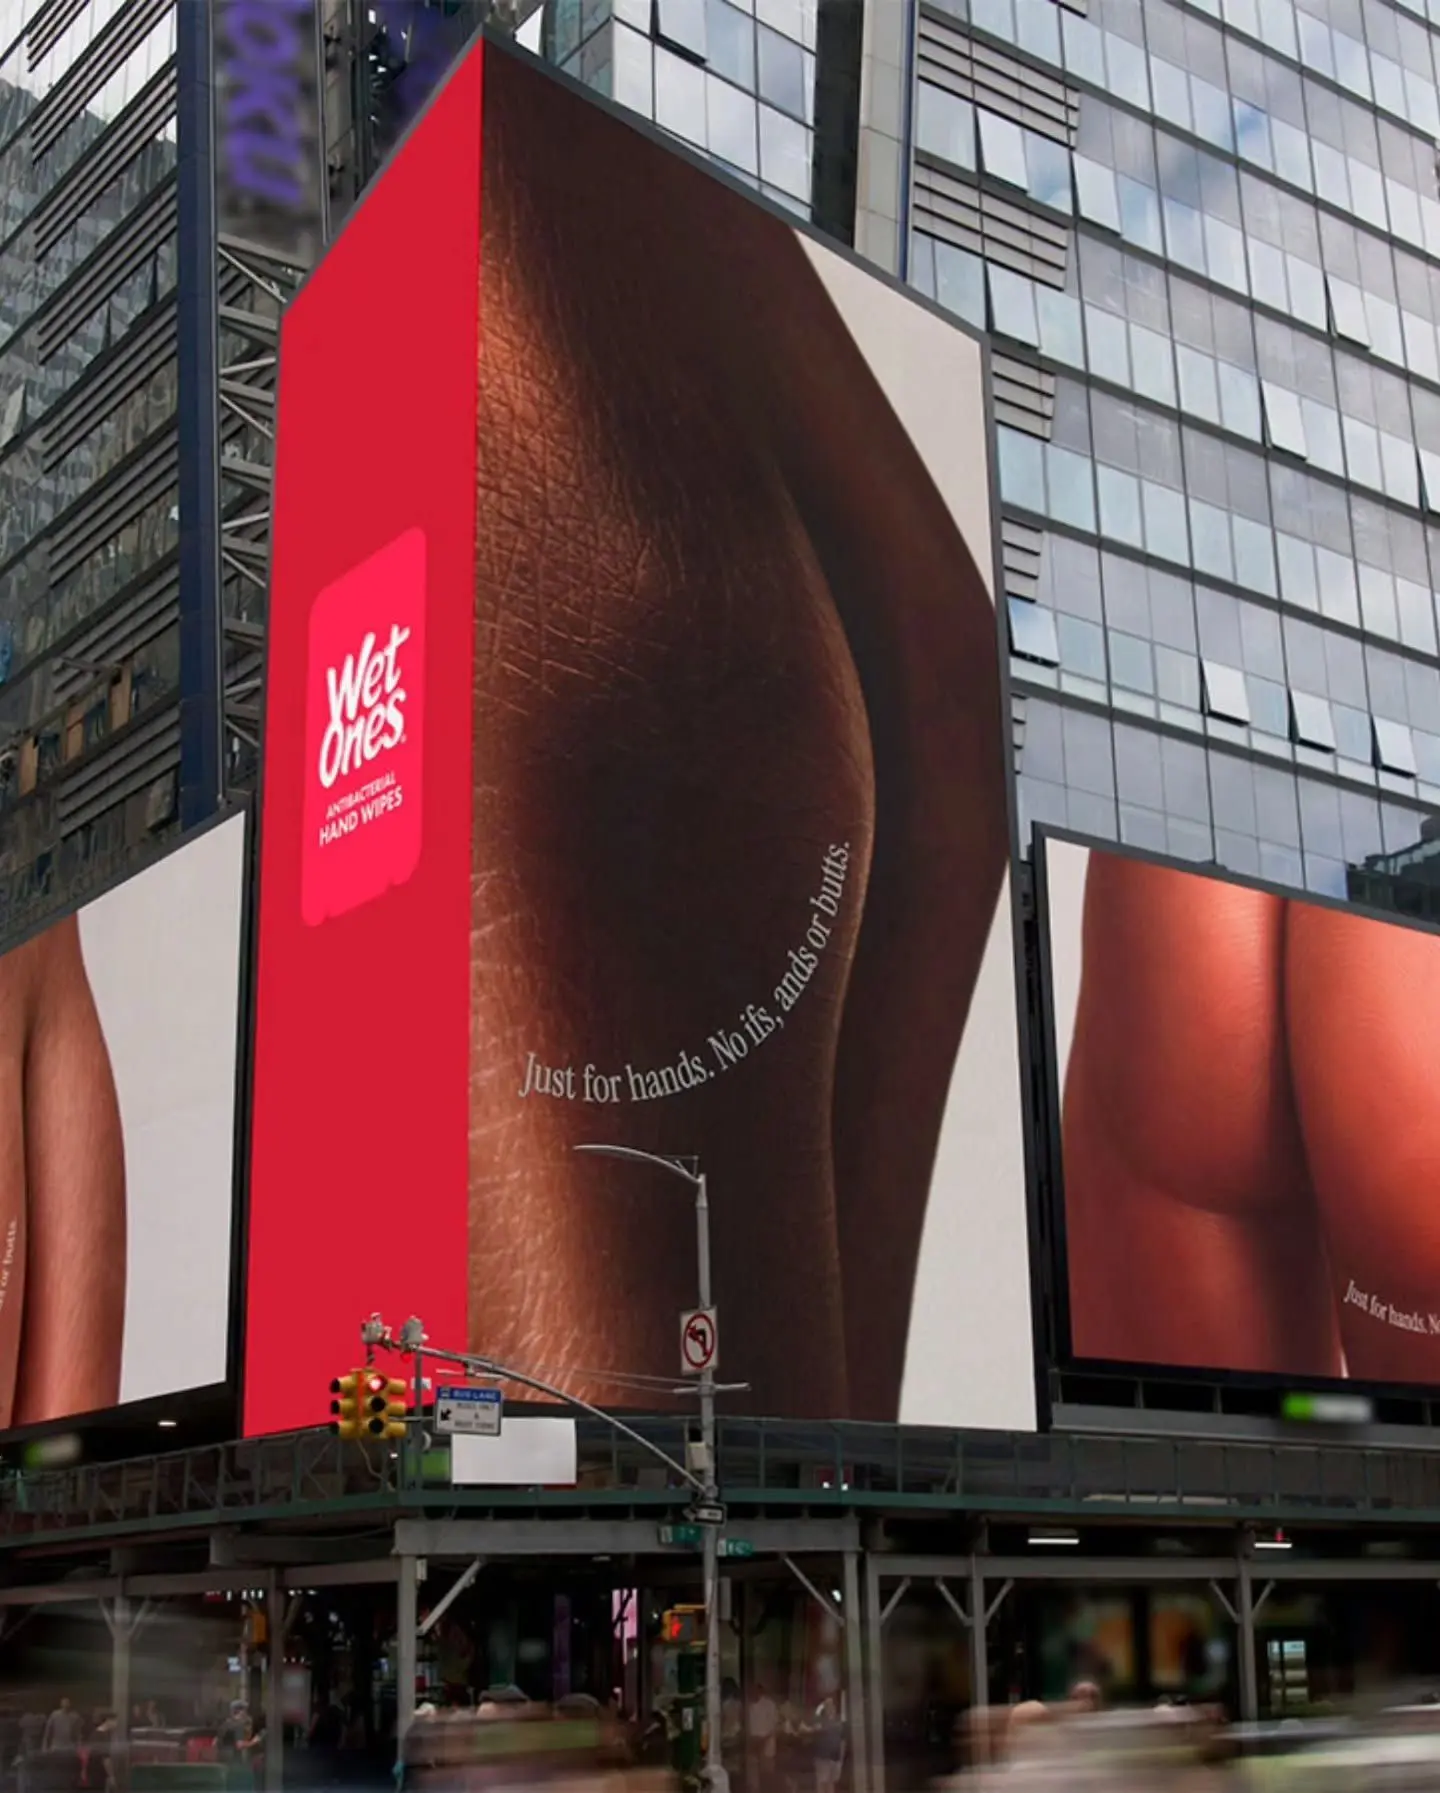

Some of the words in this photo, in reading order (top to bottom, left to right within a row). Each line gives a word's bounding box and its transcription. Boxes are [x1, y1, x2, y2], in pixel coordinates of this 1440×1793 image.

[326, 623, 411, 721] Wet
[318, 687, 407, 788] Ones
[318, 811, 359, 847] HAND
[360, 785, 403, 826] WIPES
[325, 770, 396, 820] ANTIBACTERIAL
[809, 840, 851, 917] butts.
[806, 915, 832, 950] or
[773, 946, 819, 1012] ands
[706, 1029, 749, 1071] No
[740, 1004, 785, 1047] ifs,
[518, 1051, 577, 1098] Just
[582, 1063, 622, 1103] for
[625, 1050, 716, 1102] hands.
[1343, 1279, 1369, 1312] Just
[1369, 1294, 1388, 1321] for
